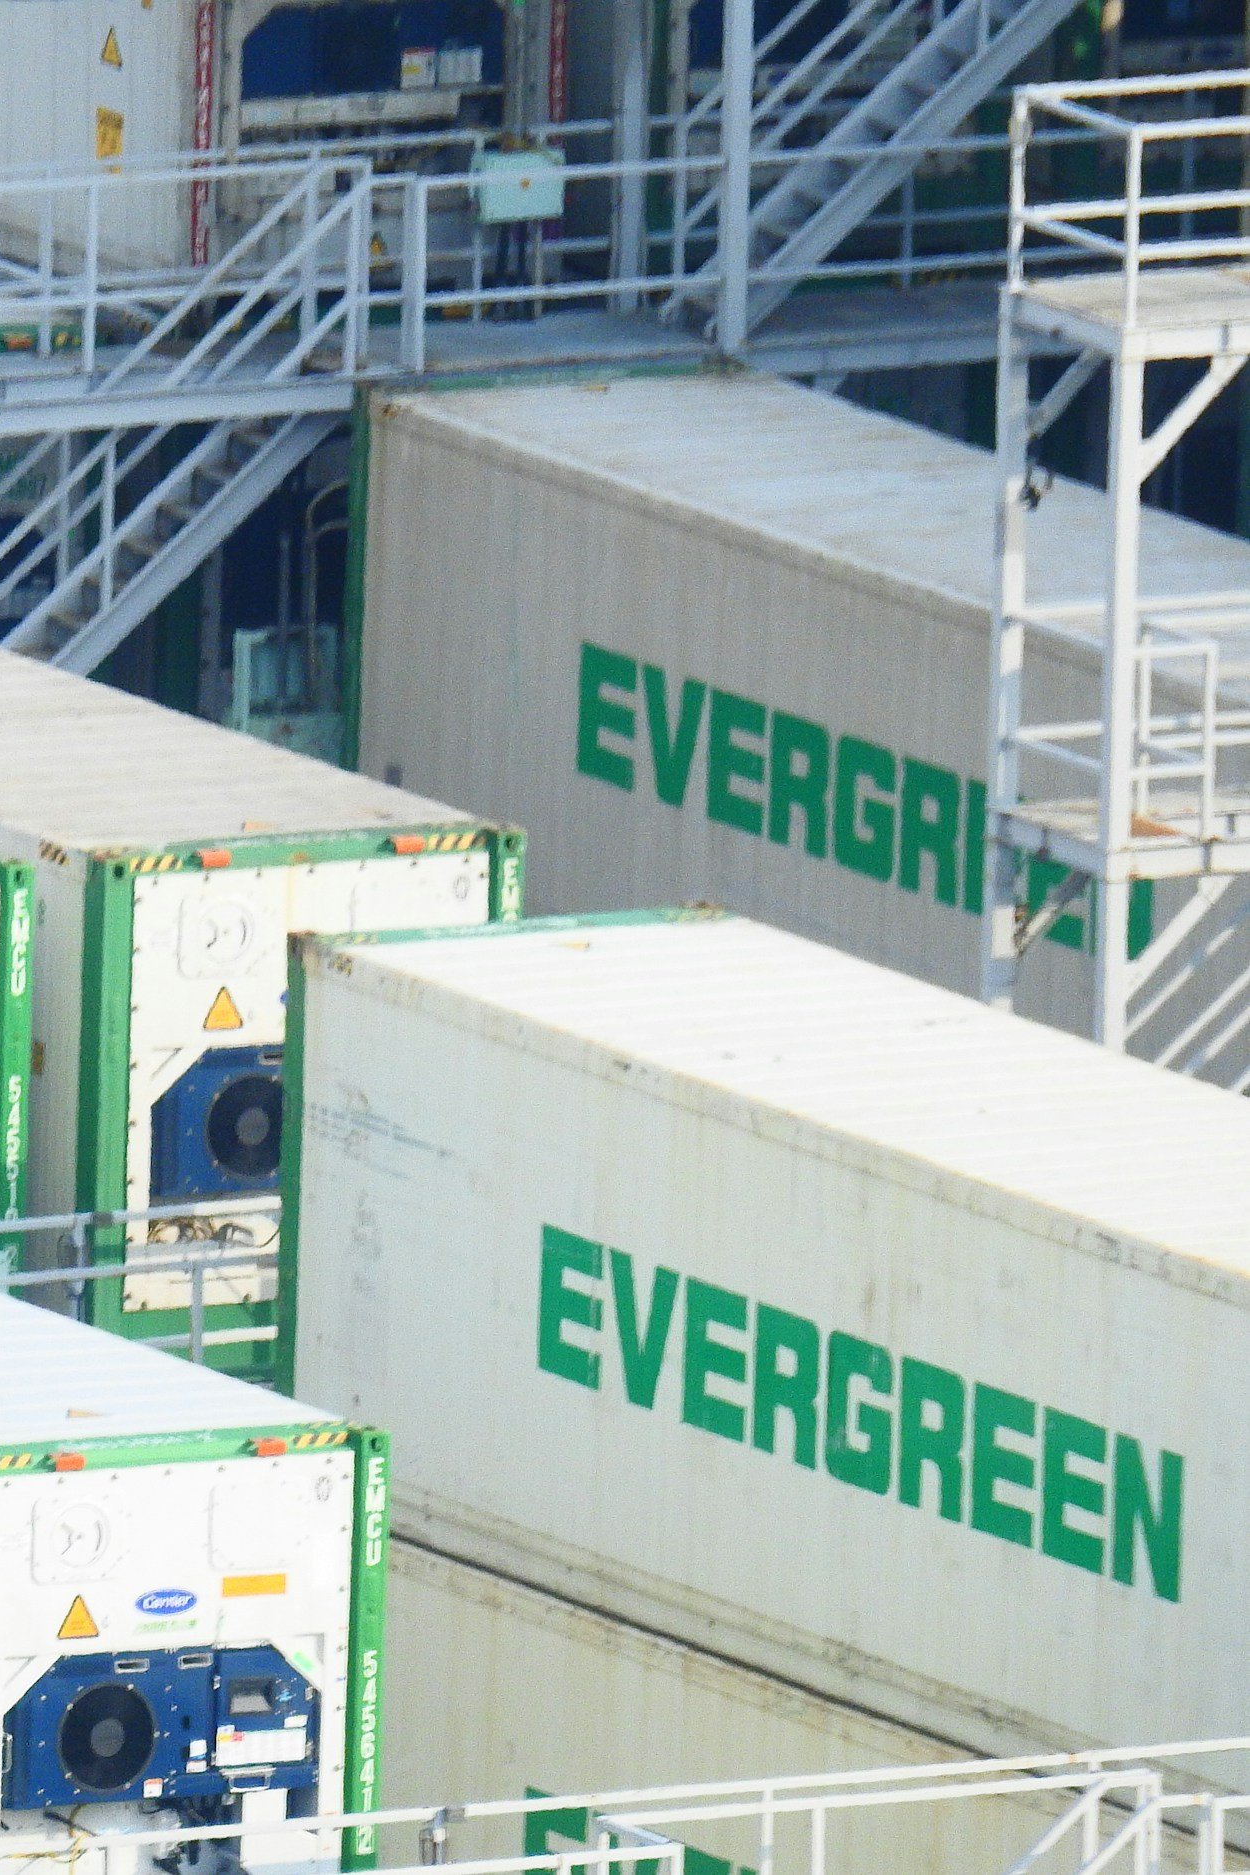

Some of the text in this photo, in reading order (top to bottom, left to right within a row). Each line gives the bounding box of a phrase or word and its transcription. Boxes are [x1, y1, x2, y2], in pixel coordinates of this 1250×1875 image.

[10, 888, 30, 997] EMCU
[537, 1224, 1185, 1603] EVERGREEN
[366, 1456, 386, 1566] EMCU
